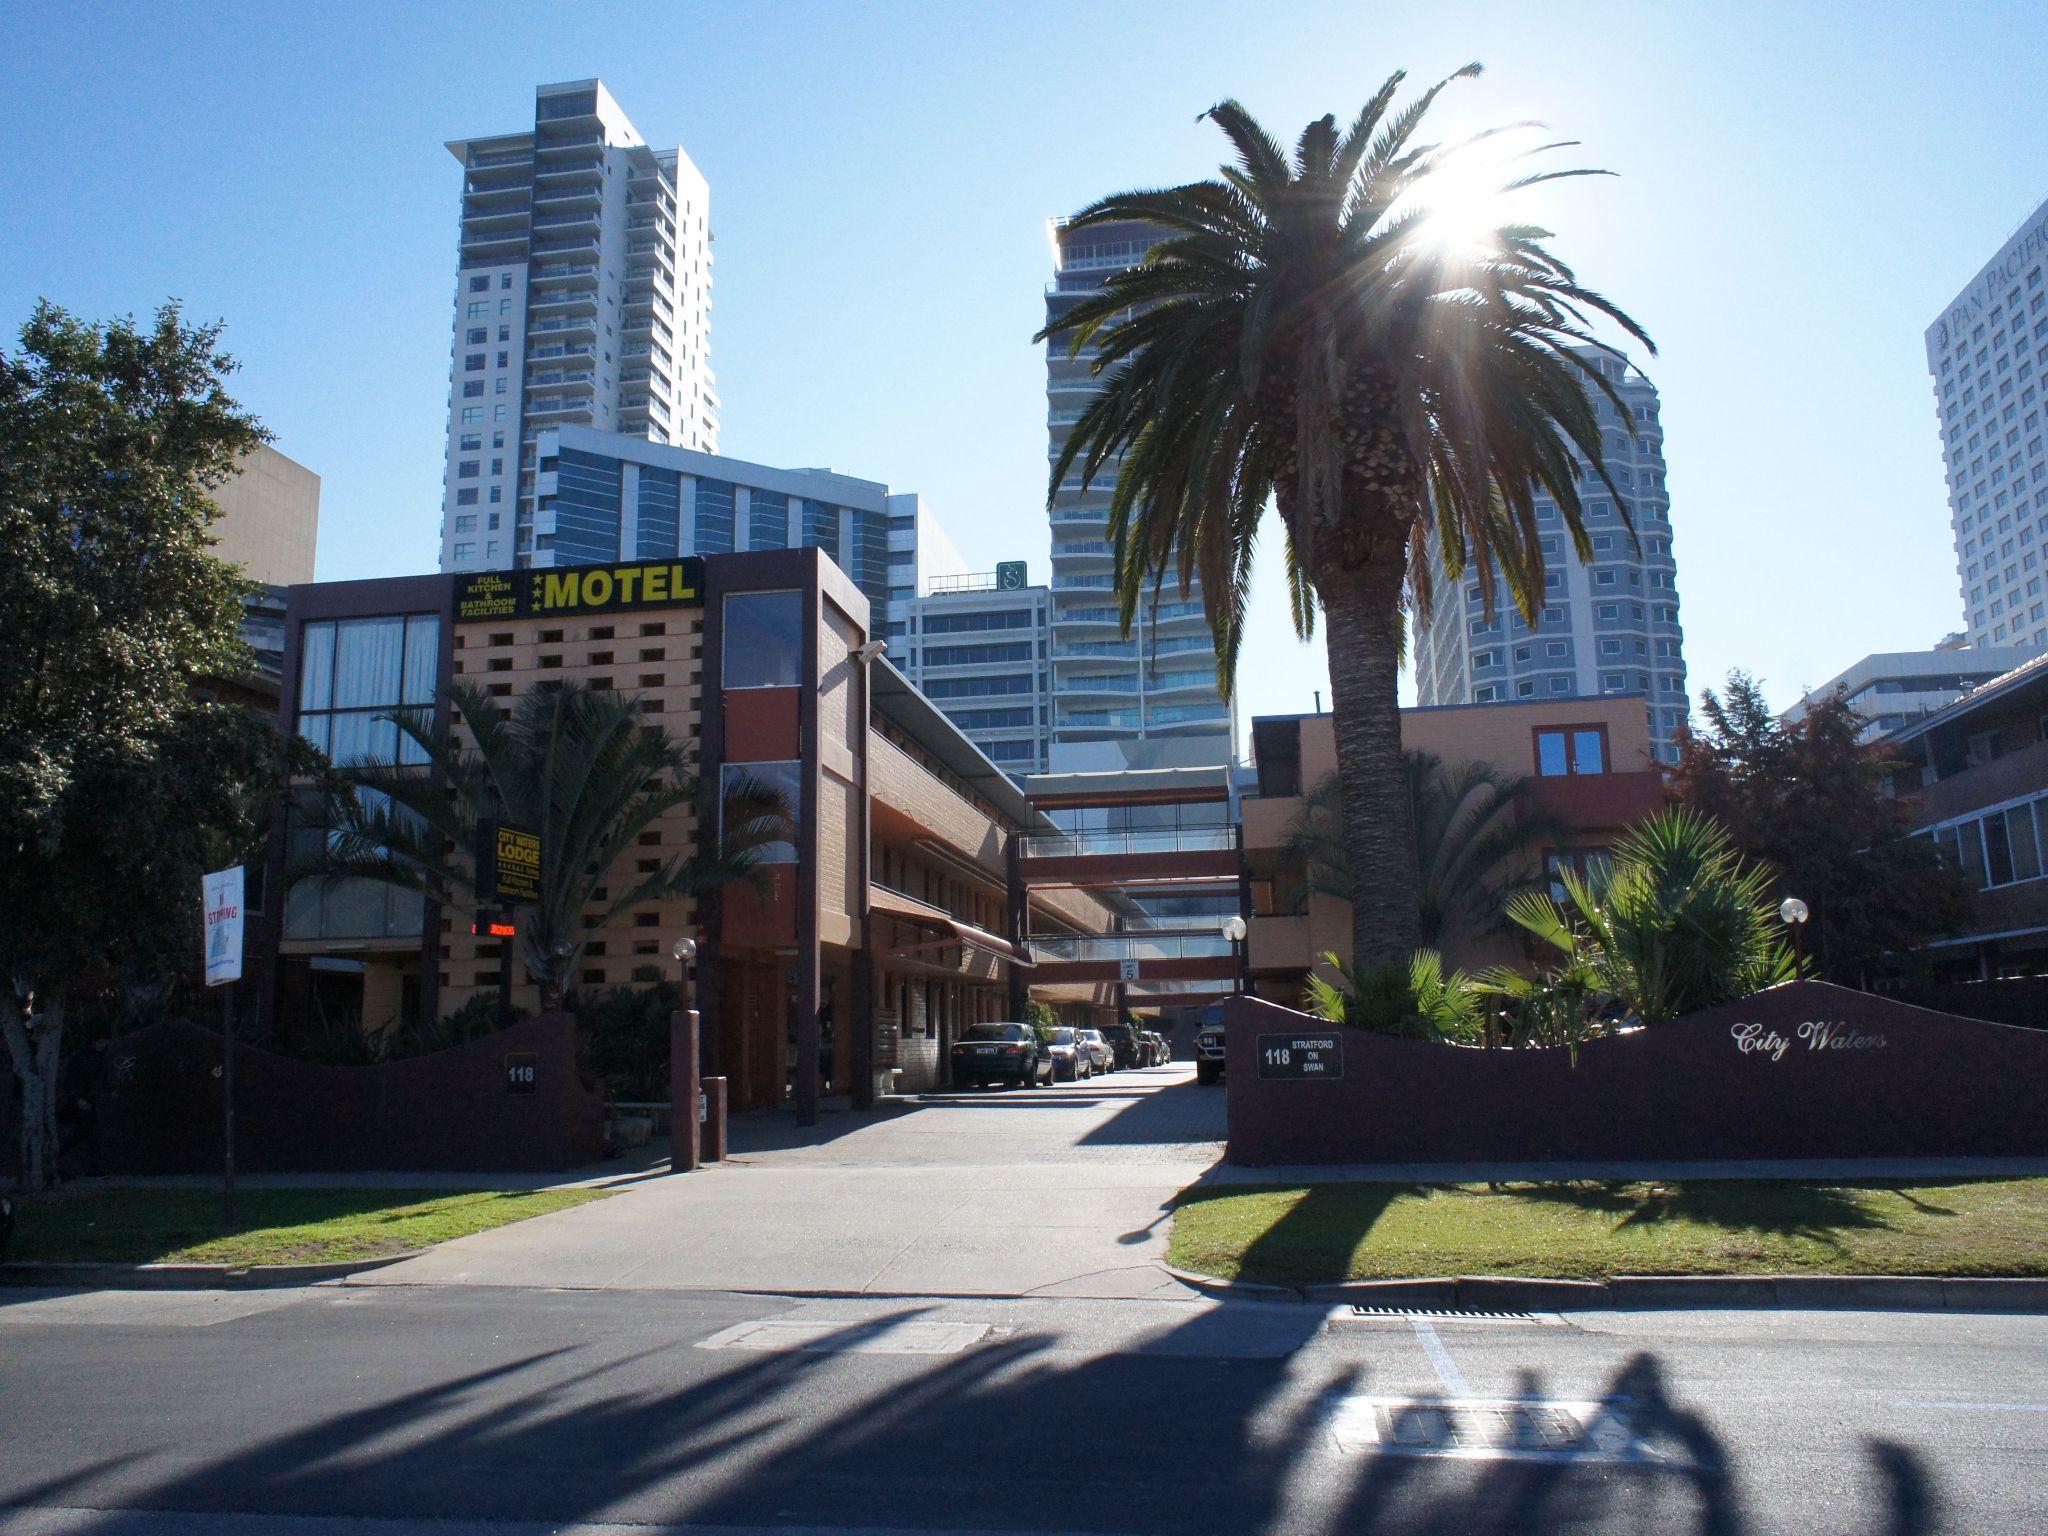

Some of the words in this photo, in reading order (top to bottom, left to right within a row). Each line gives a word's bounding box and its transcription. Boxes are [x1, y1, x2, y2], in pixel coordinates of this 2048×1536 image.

[1950, 288, 1983, 337] PAN
[477, 576, 501, 584] FULL
[467, 583, 511, 593] KITCHEN
[544, 565, 695, 608] MOTEL
[461, 598, 516, 609] BATHROOM
[461, 606, 515, 616] FACILITIES
[498, 842, 540, 864] LODGE
[1126, 969, 1134, 979] 5
[1292, 1040, 1334, 1049] STRATFORD
[1731, 1023, 1790, 1061] City
[1797, 1021, 1887, 1050] Waters
[1265, 1048, 1290, 1065] 118
[1307, 1051, 1319, 1060] ON
[1303, 1063, 1324, 1072] SWAN
[509, 1067, 533, 1082] 118
